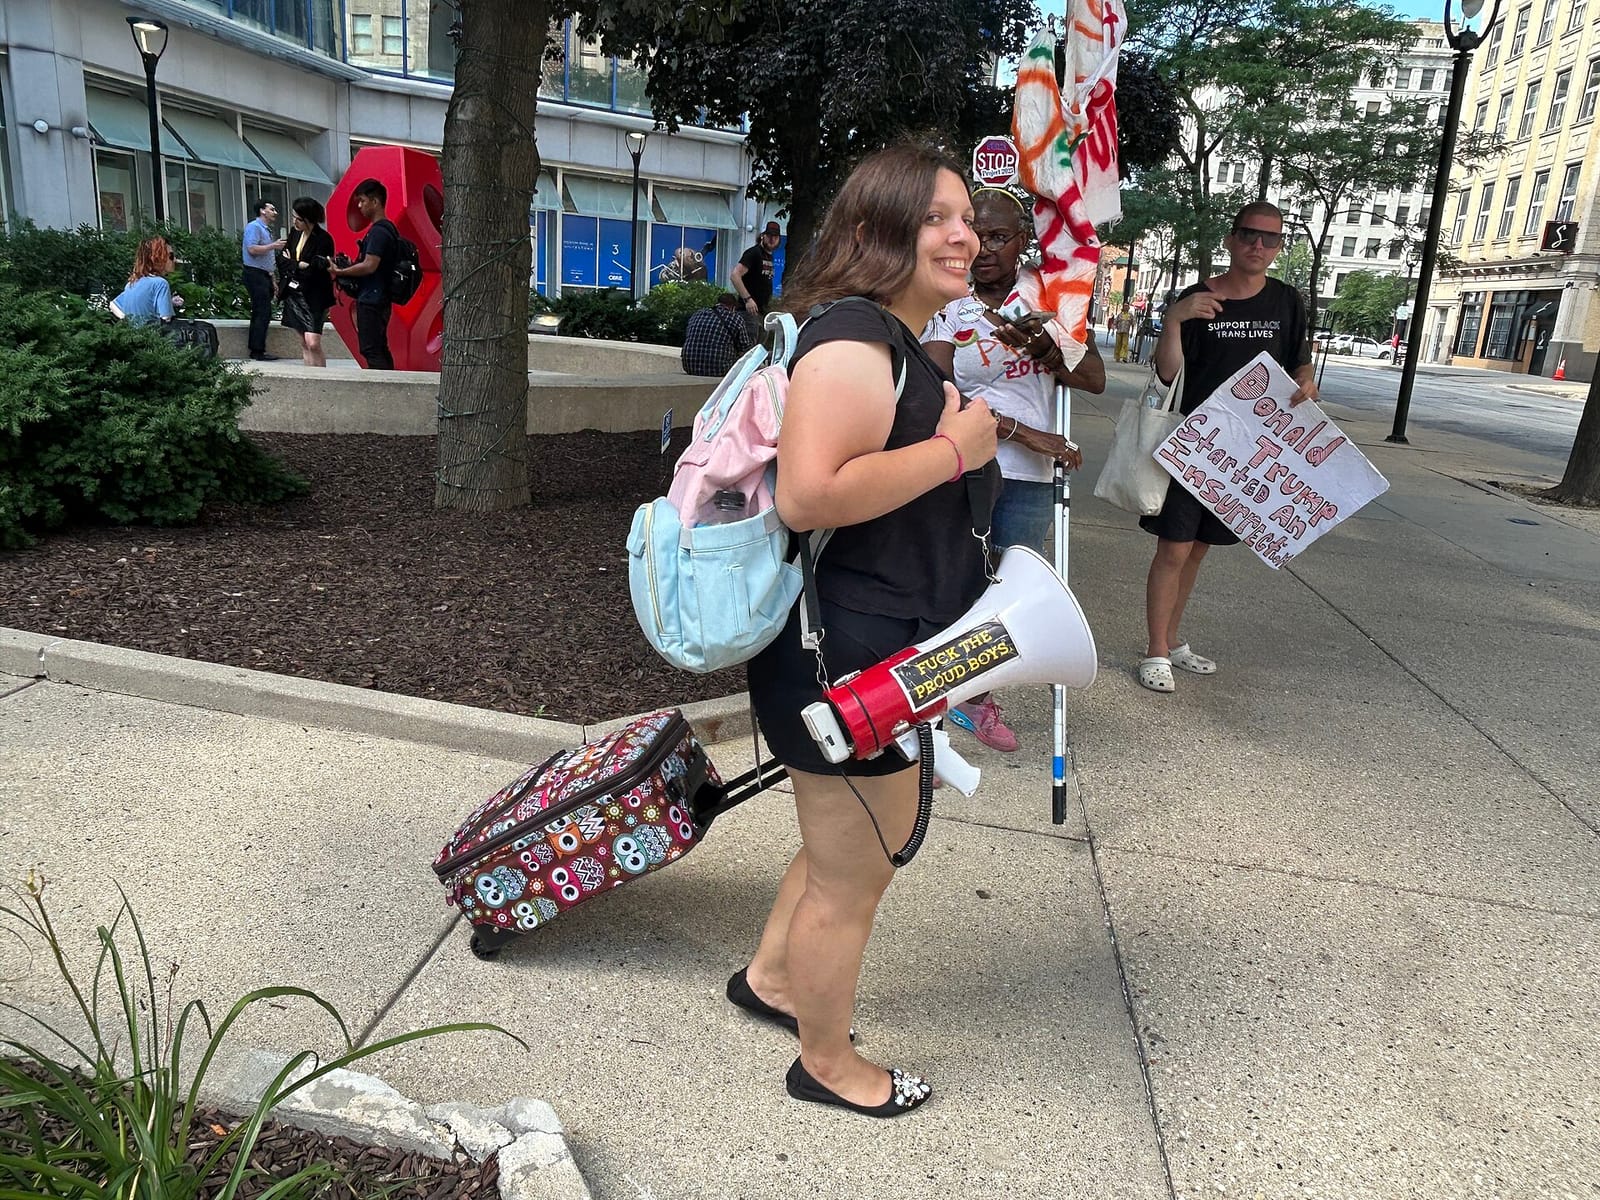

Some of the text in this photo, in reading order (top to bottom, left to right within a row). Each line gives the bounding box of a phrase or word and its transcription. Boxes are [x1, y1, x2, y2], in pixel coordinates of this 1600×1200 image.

[977, 152, 1015, 170] STOP
[1207, 320, 1281, 332] SUPPORT BLACK
[1216, 329, 1274, 339] TRANS LIVES
[1230, 362, 1347, 467] Donald
[1247, 434, 1339, 528] Trump
[1268, 504, 1308, 541] An
[914, 642, 1010, 700] PROUD BOYS
[916, 629, 993, 677] FUCK THE
